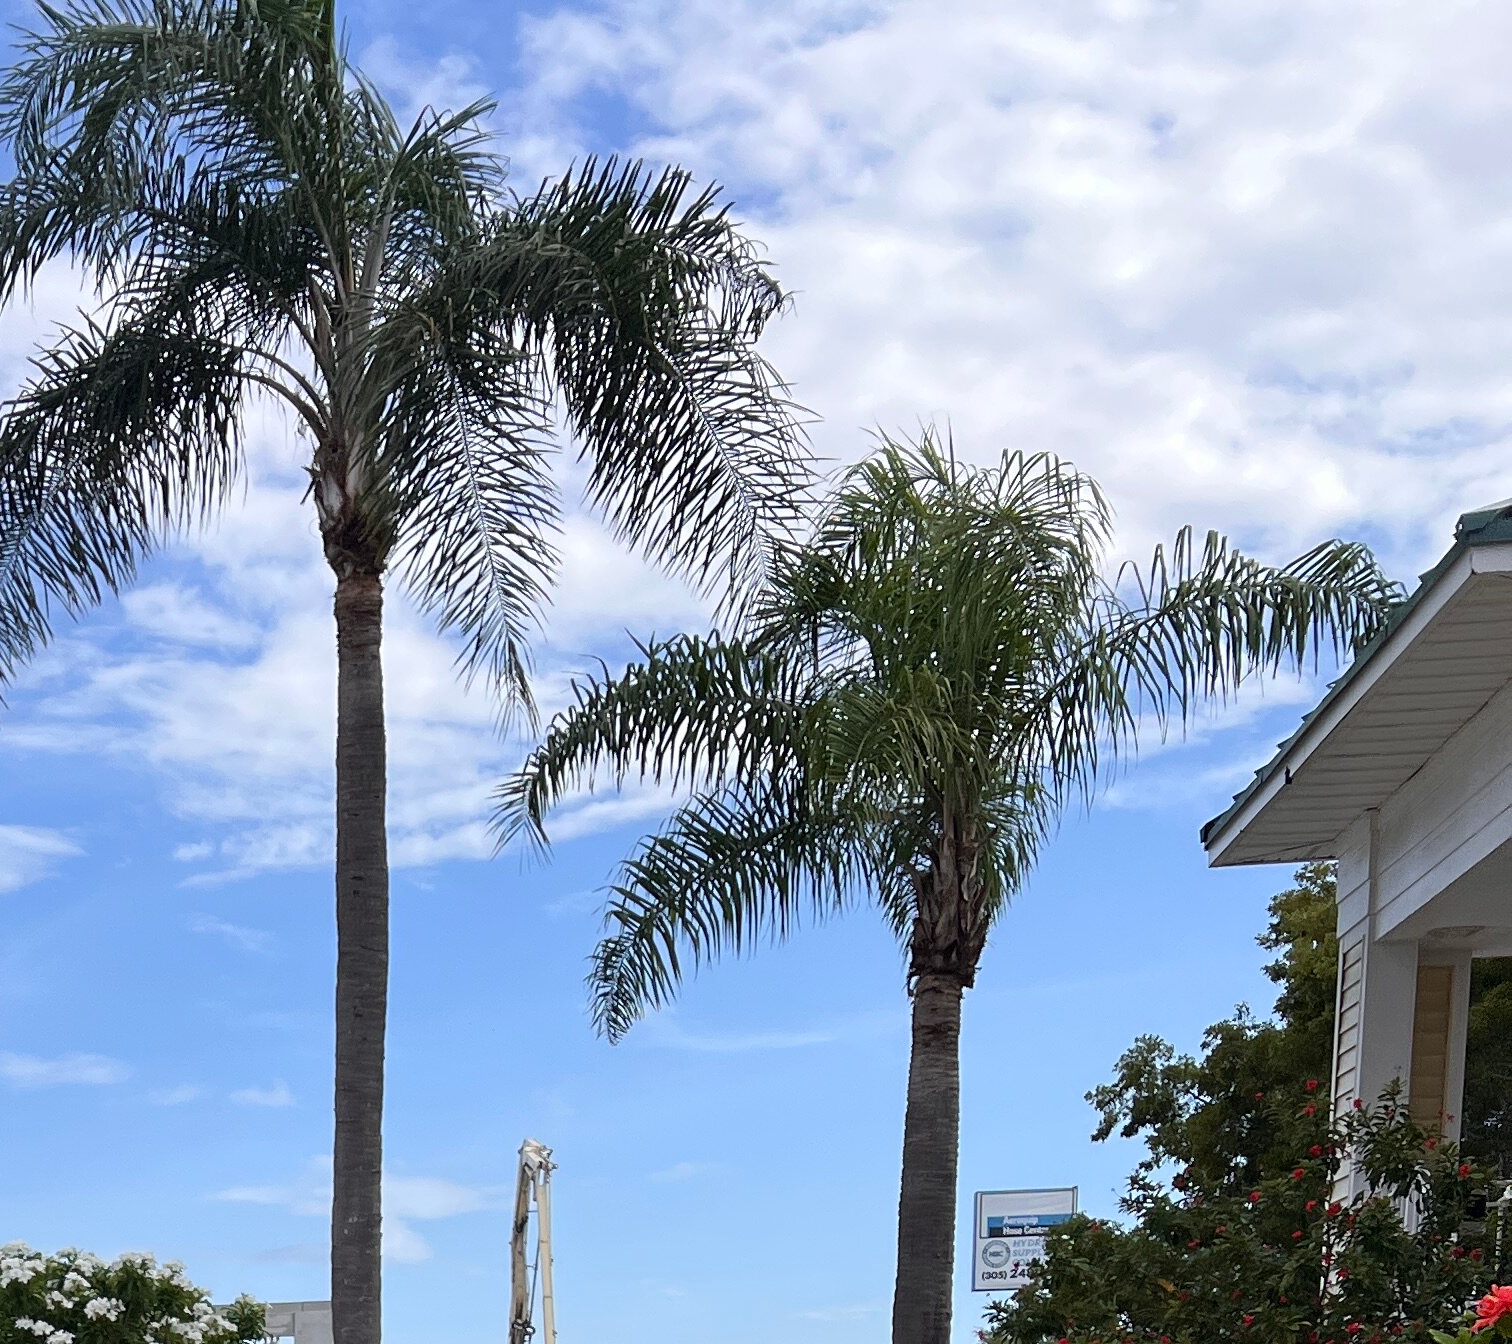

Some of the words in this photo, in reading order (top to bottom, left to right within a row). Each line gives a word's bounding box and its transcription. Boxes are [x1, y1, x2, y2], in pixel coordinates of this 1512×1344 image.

[1013, 1239, 1041, 1247] HYDR
[1012, 1249, 1042, 1257] SUPPL
[982, 1271, 1007, 1281] (305)
